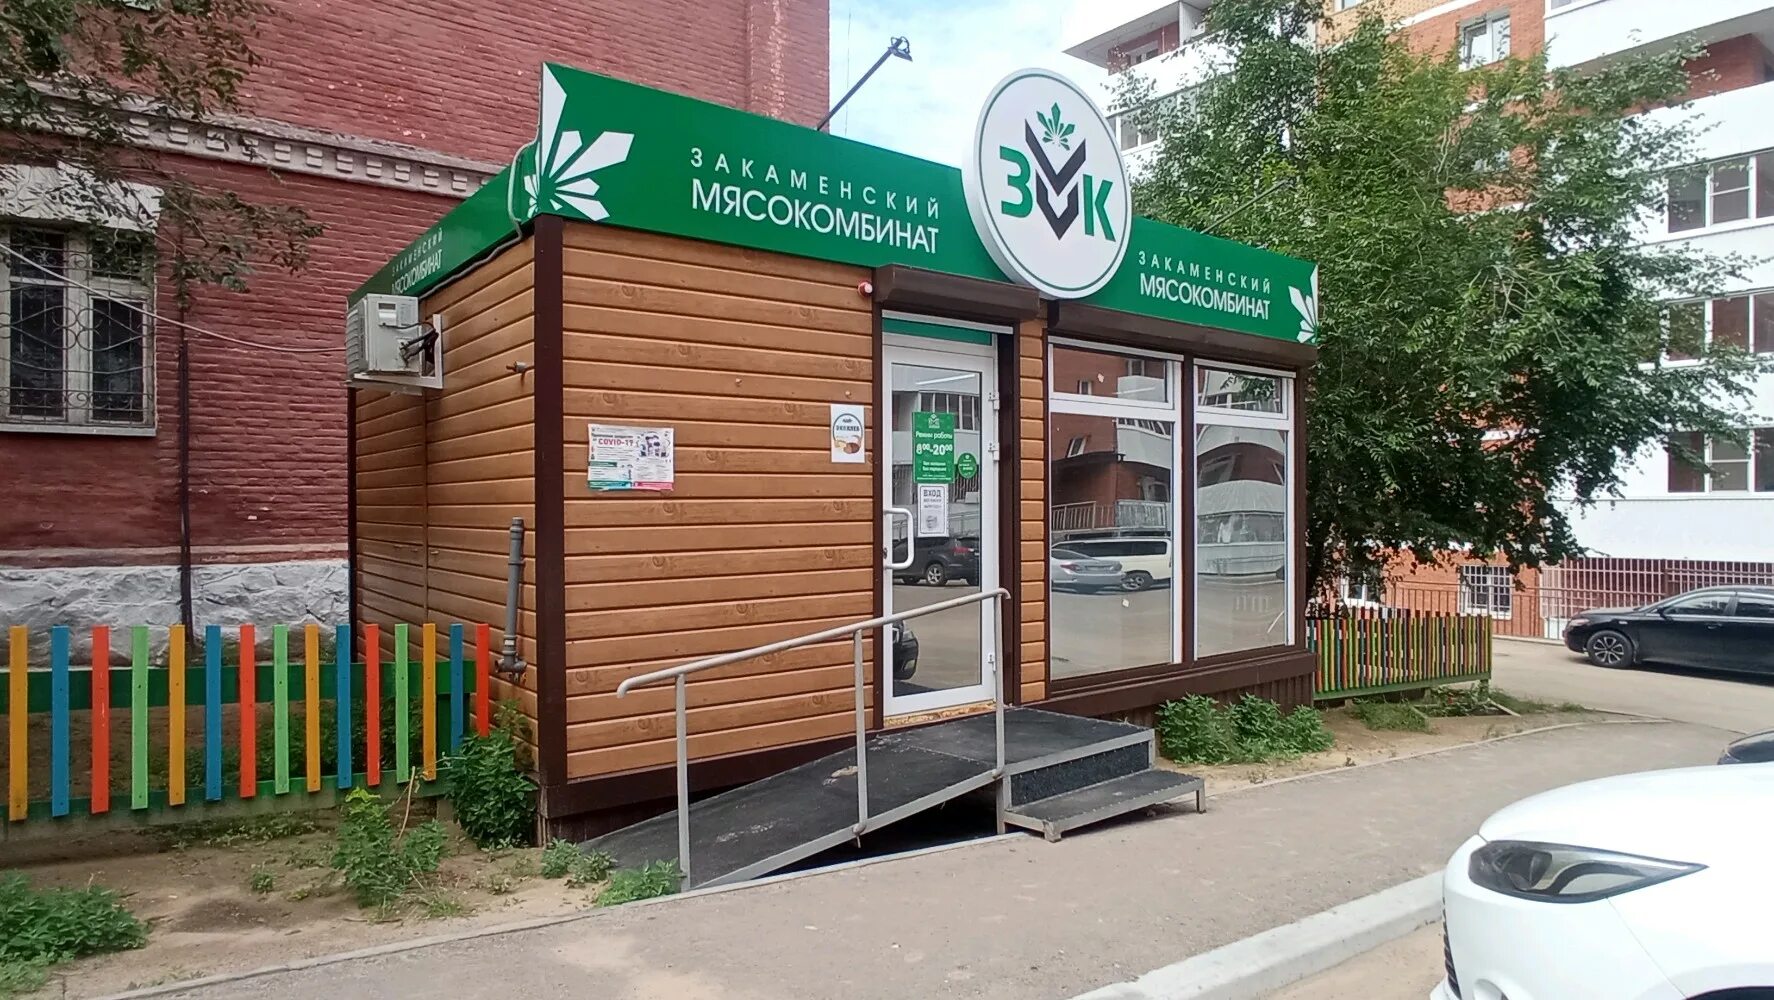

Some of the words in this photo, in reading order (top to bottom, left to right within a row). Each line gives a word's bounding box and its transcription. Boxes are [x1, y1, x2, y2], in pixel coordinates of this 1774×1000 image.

[690, 147, 939, 219] ЗАКАМЕНСКИЙ
[692, 178, 939, 254] МЯСОКОМБИНАТ
[1138, 250, 1271, 294] ЗАКАМЕНСКИЙ
[1140, 273, 1271, 320] МЯСОКОМБИНАТ
[598, 438, 634, 446] COVID-19
